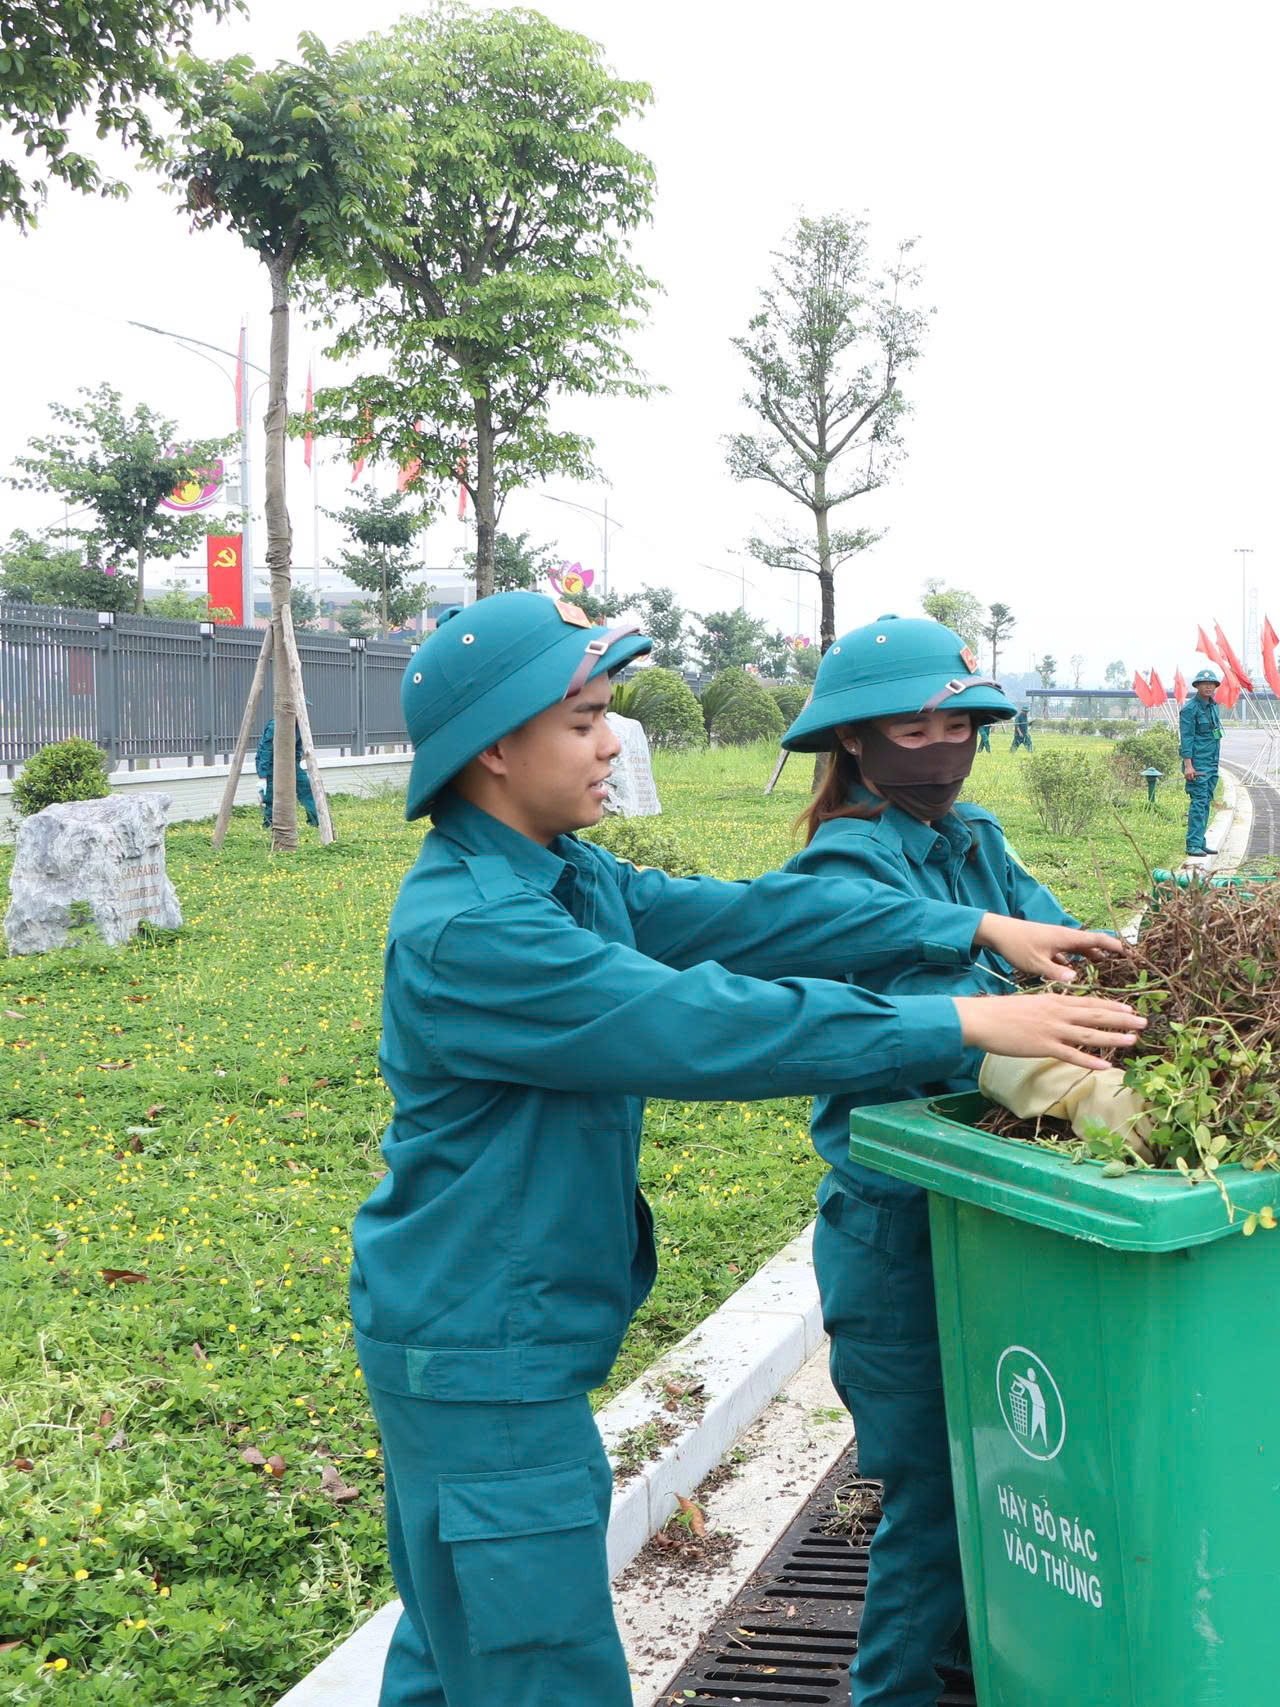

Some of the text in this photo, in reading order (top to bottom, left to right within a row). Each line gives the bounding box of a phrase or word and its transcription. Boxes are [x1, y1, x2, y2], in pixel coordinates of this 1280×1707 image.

[1031, 1495, 1056, 1542] BỎ
[1059, 1517, 1098, 1562] RÁC
[1003, 1528, 1103, 1609] VÀO THÙNG
